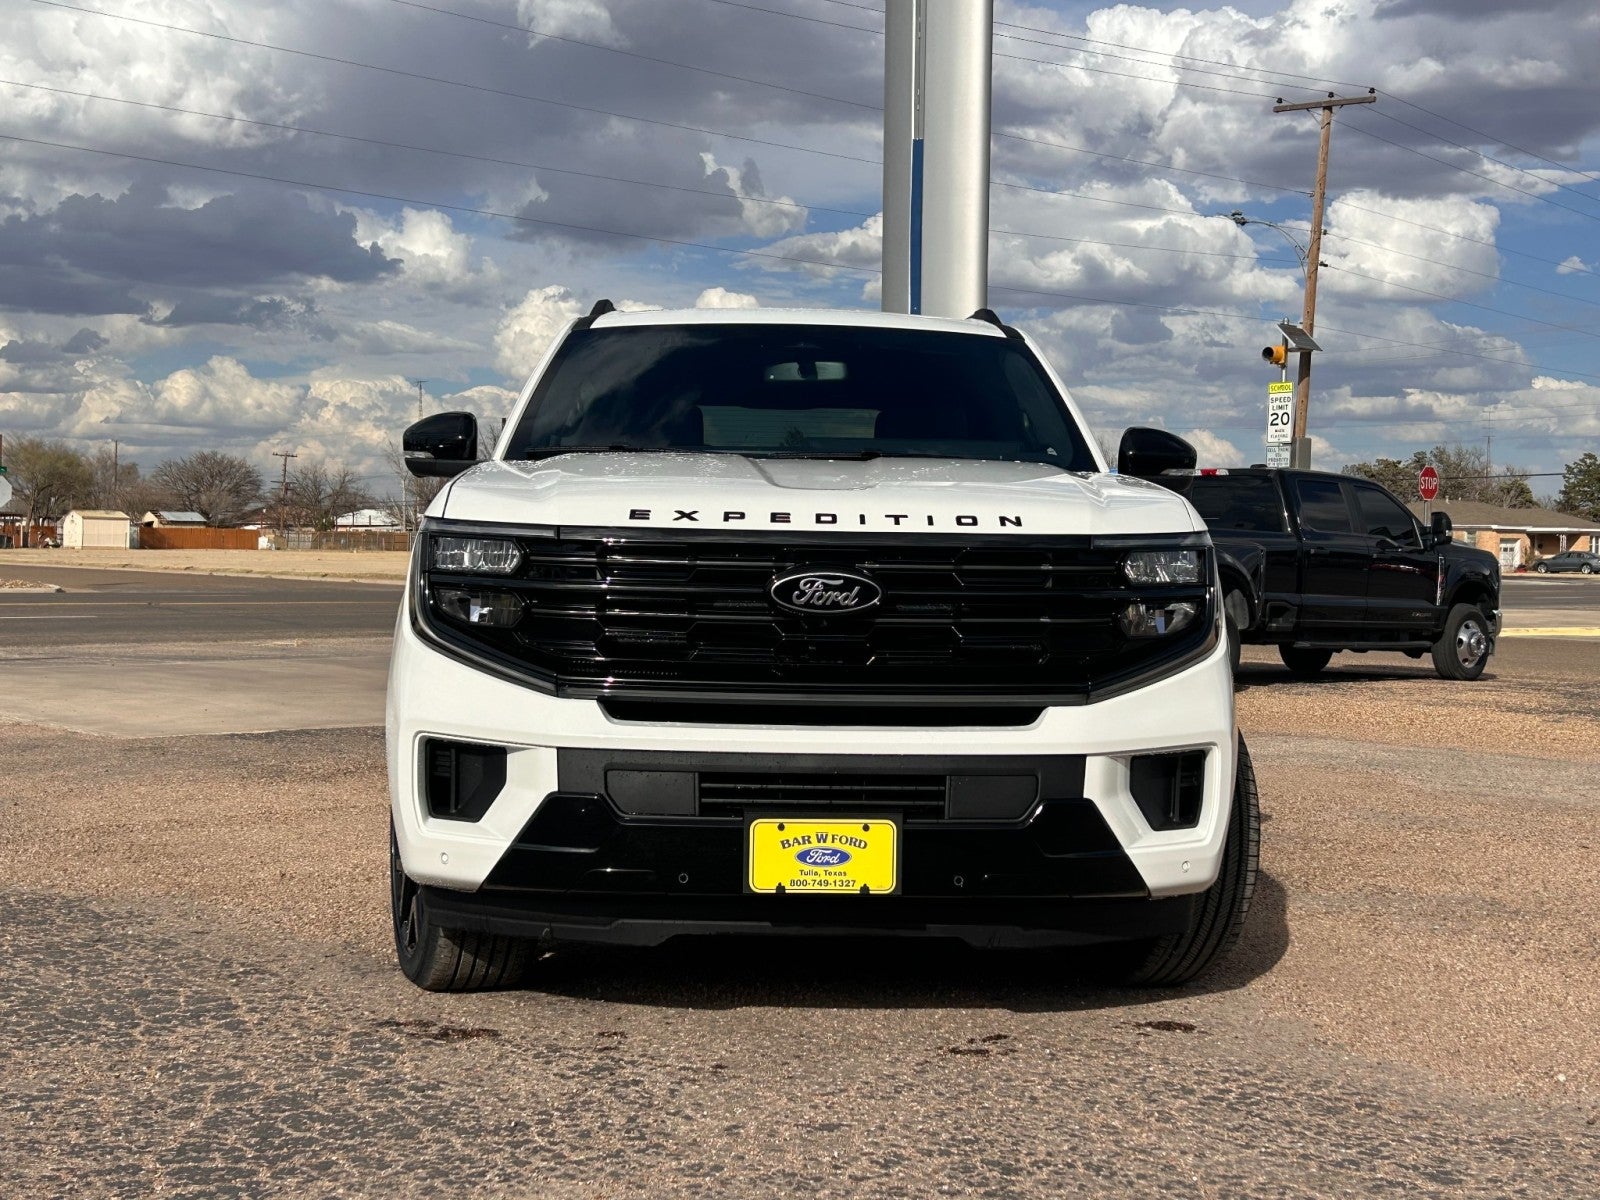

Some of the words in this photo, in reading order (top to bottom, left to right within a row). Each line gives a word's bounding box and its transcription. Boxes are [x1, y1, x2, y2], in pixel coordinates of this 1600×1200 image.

[1270, 396, 1291, 404] SPEED
[1269, 412, 1290, 426] 20
[1420, 476, 1438, 490] STOP
[628, 508, 1024, 528] EXPEDITION
[792, 576, 860, 608] Ford
[780, 835, 813, 850] BAR
[815, 832, 829, 844] W
[831, 834, 868, 850] FORD
[806, 848, 841, 864] Ford
[824, 869, 847, 877] Texas
[789, 879, 857, 888] 800-749-1327
